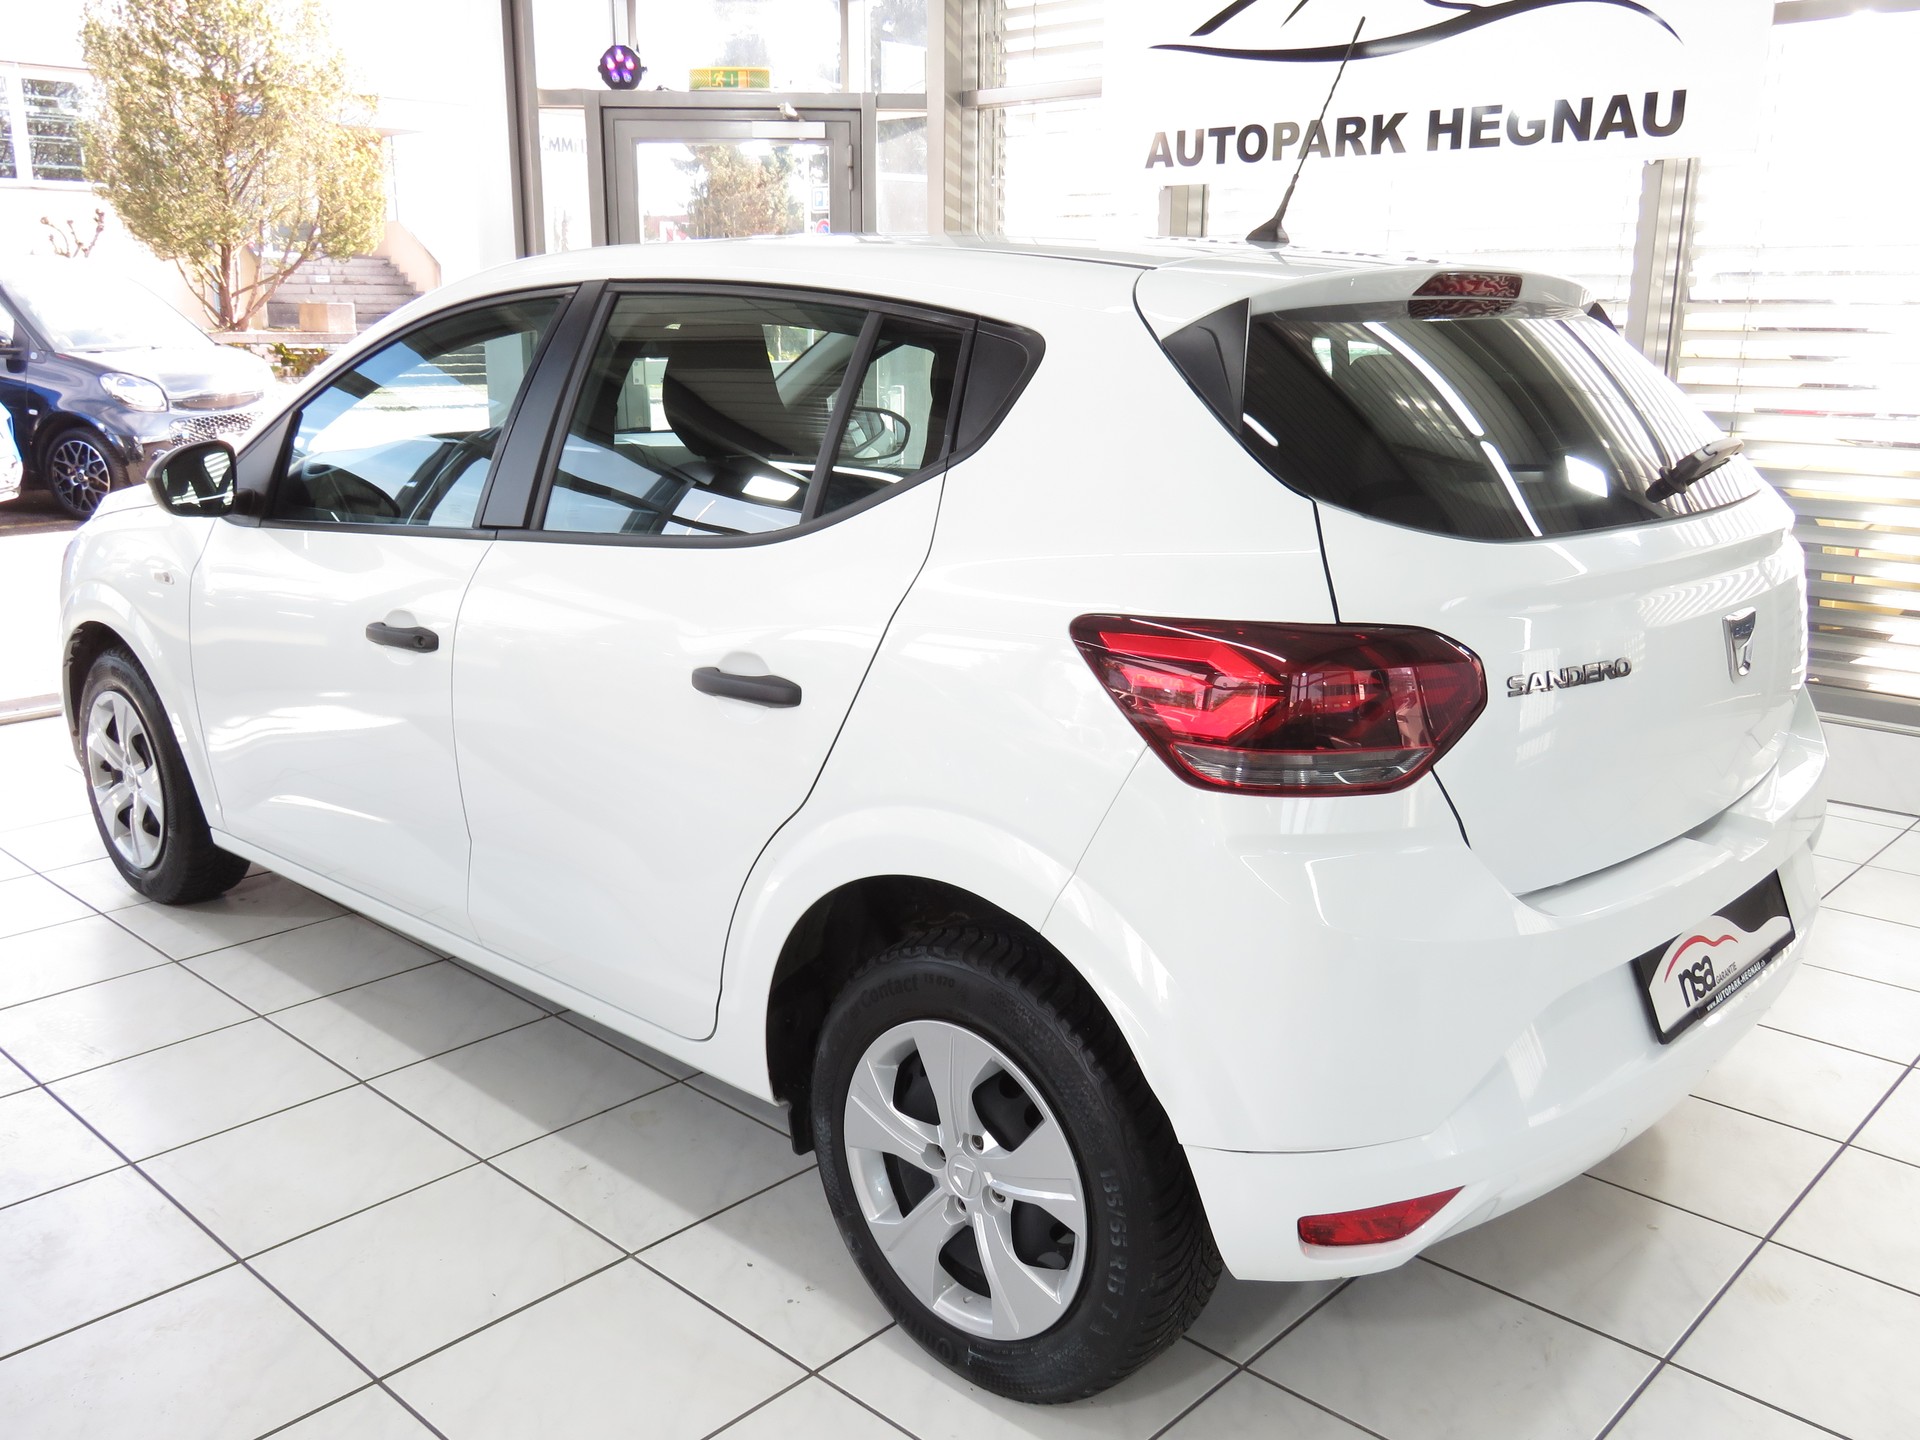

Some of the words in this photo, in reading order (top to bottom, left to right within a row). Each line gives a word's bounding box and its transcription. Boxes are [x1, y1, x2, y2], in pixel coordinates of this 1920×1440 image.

[1144, 111, 1408, 169] AUTOPARK
[1426, 89, 1687, 152] HEGNAU
[1506, 656, 1633, 698] SANDERO
[1677, 955, 1716, 1008] nsa
[1715, 961, 1738, 985] GARANTIE
